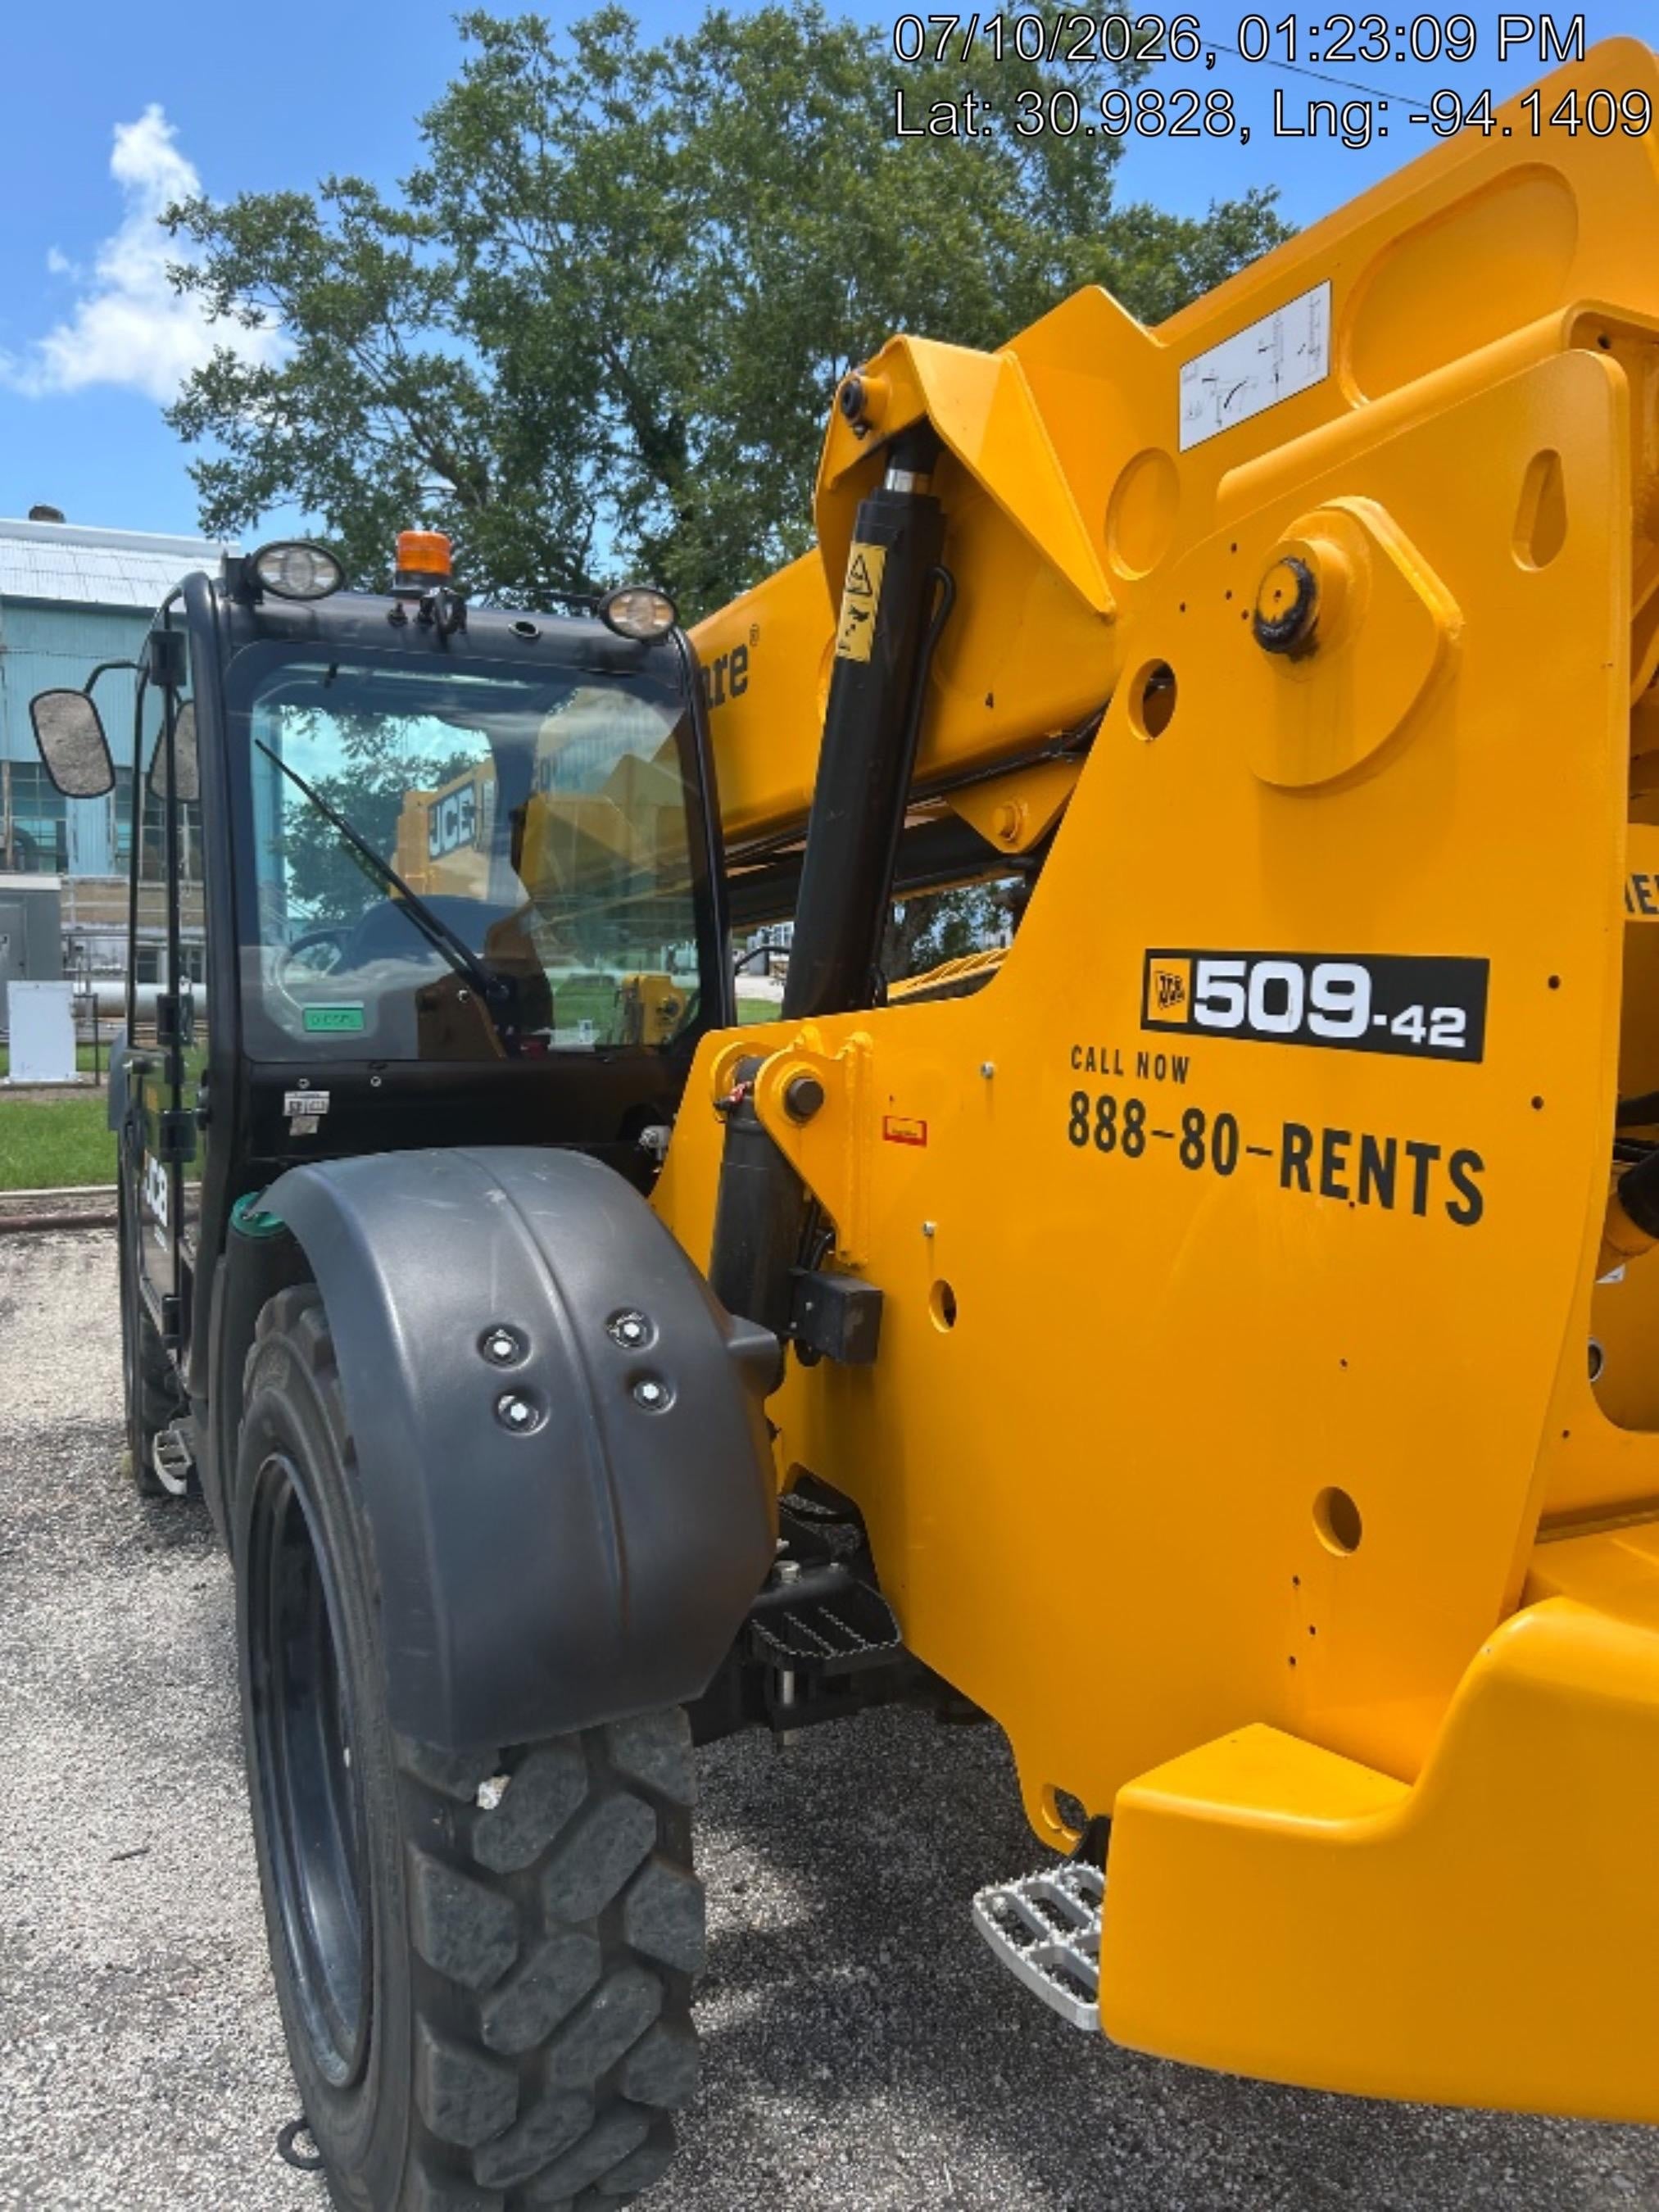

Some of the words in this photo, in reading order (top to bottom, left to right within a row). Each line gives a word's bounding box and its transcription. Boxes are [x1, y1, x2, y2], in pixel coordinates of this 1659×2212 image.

[1194, 960, 1466, 1048] 509-42
[1071, 1045, 1124, 1076] CALL
[1137, 1051, 1190, 1084] NOW
[1068, 1090, 1485, 1226] 888-80-RENTS
